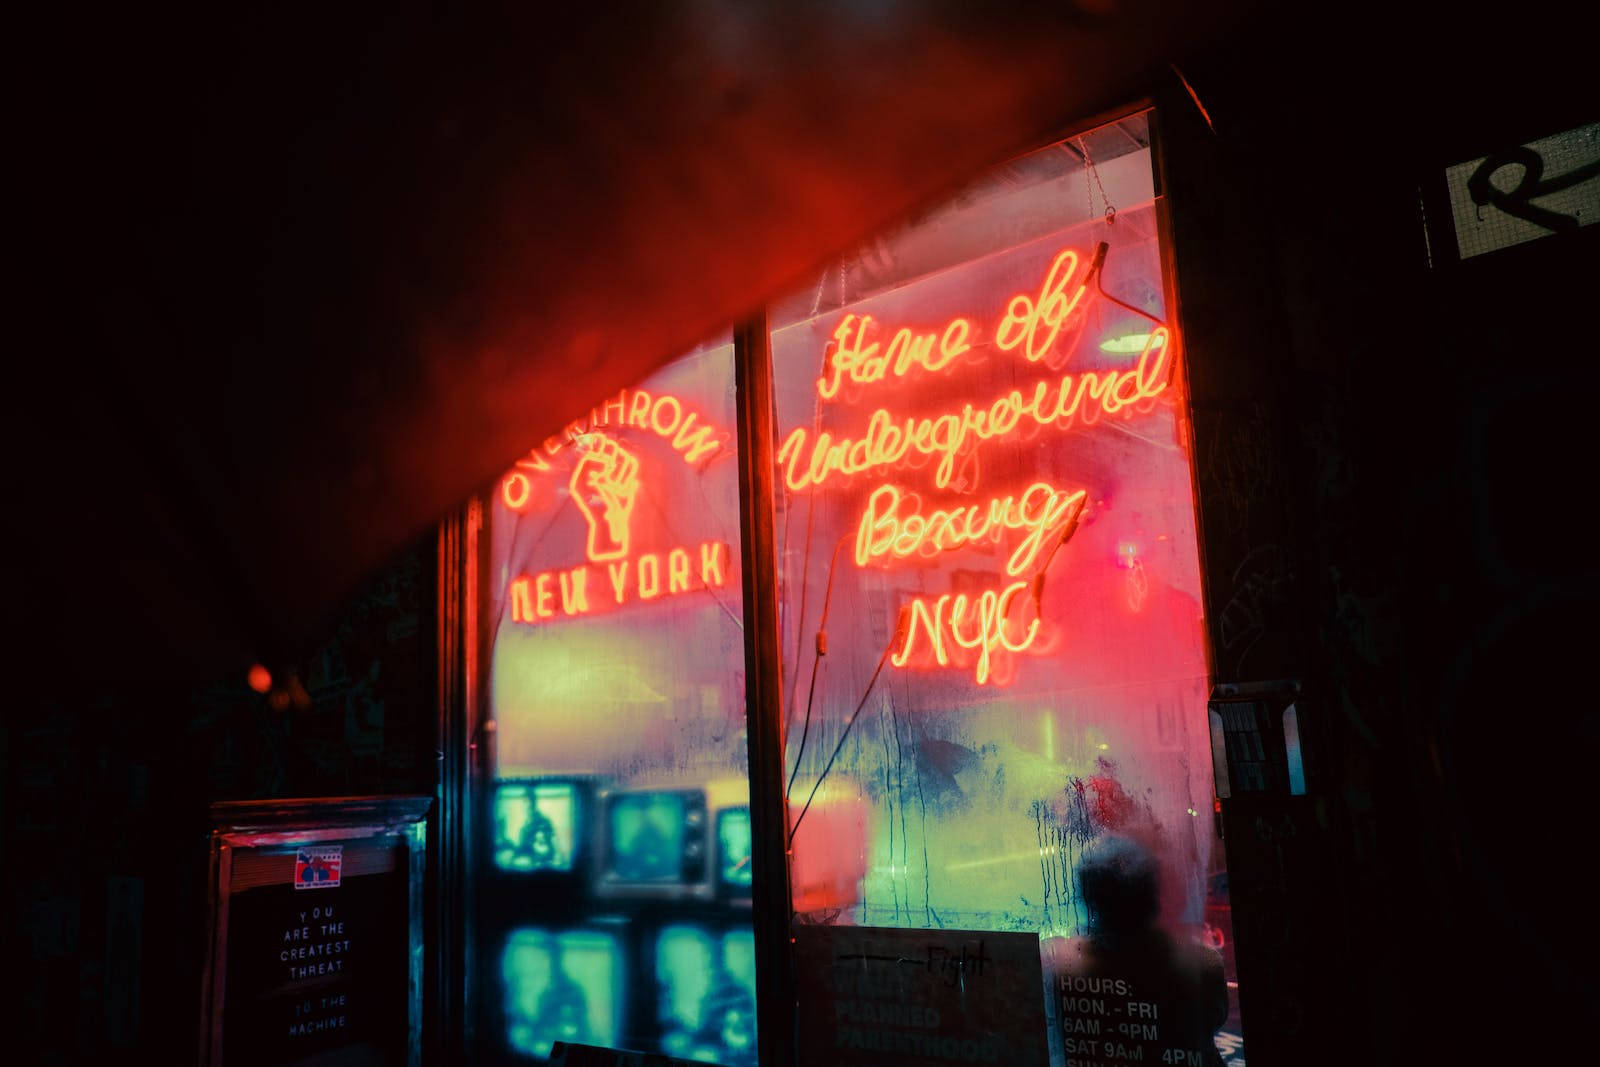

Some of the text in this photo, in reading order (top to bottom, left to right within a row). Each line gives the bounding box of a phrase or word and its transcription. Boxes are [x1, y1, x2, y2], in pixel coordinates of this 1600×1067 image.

[817, 250, 1086, 399] Home of
[777, 325, 1170, 491] Underground
[855, 482, 1087, 576] Boxing
[510, 542, 722, 622] NEW YORK
[891, 581, 1041, 685] NYC
[298, 904, 335, 922] YOU
[284, 921, 345, 942] ARE THE
[290, 959, 343, 979] THREAT
[926, 940, 992, 988] Fight
[320, 992, 346, 1008] THE
[1060, 976, 1134, 997] HOURS:
[833, 999, 943, 1029] PLANNED
[1126, 1002, 1159, 1020] FRI
[288, 1015, 346, 1038] MACHINE
[1063, 1017, 1100, 1035] 6AM
[1118, 1023, 1159, 1041] 9PM
[1064, 1037, 1098, 1056] SAT
[1103, 1041, 1144, 1062] 9AM
[1161, 1047, 1202, 1067] 4PM
